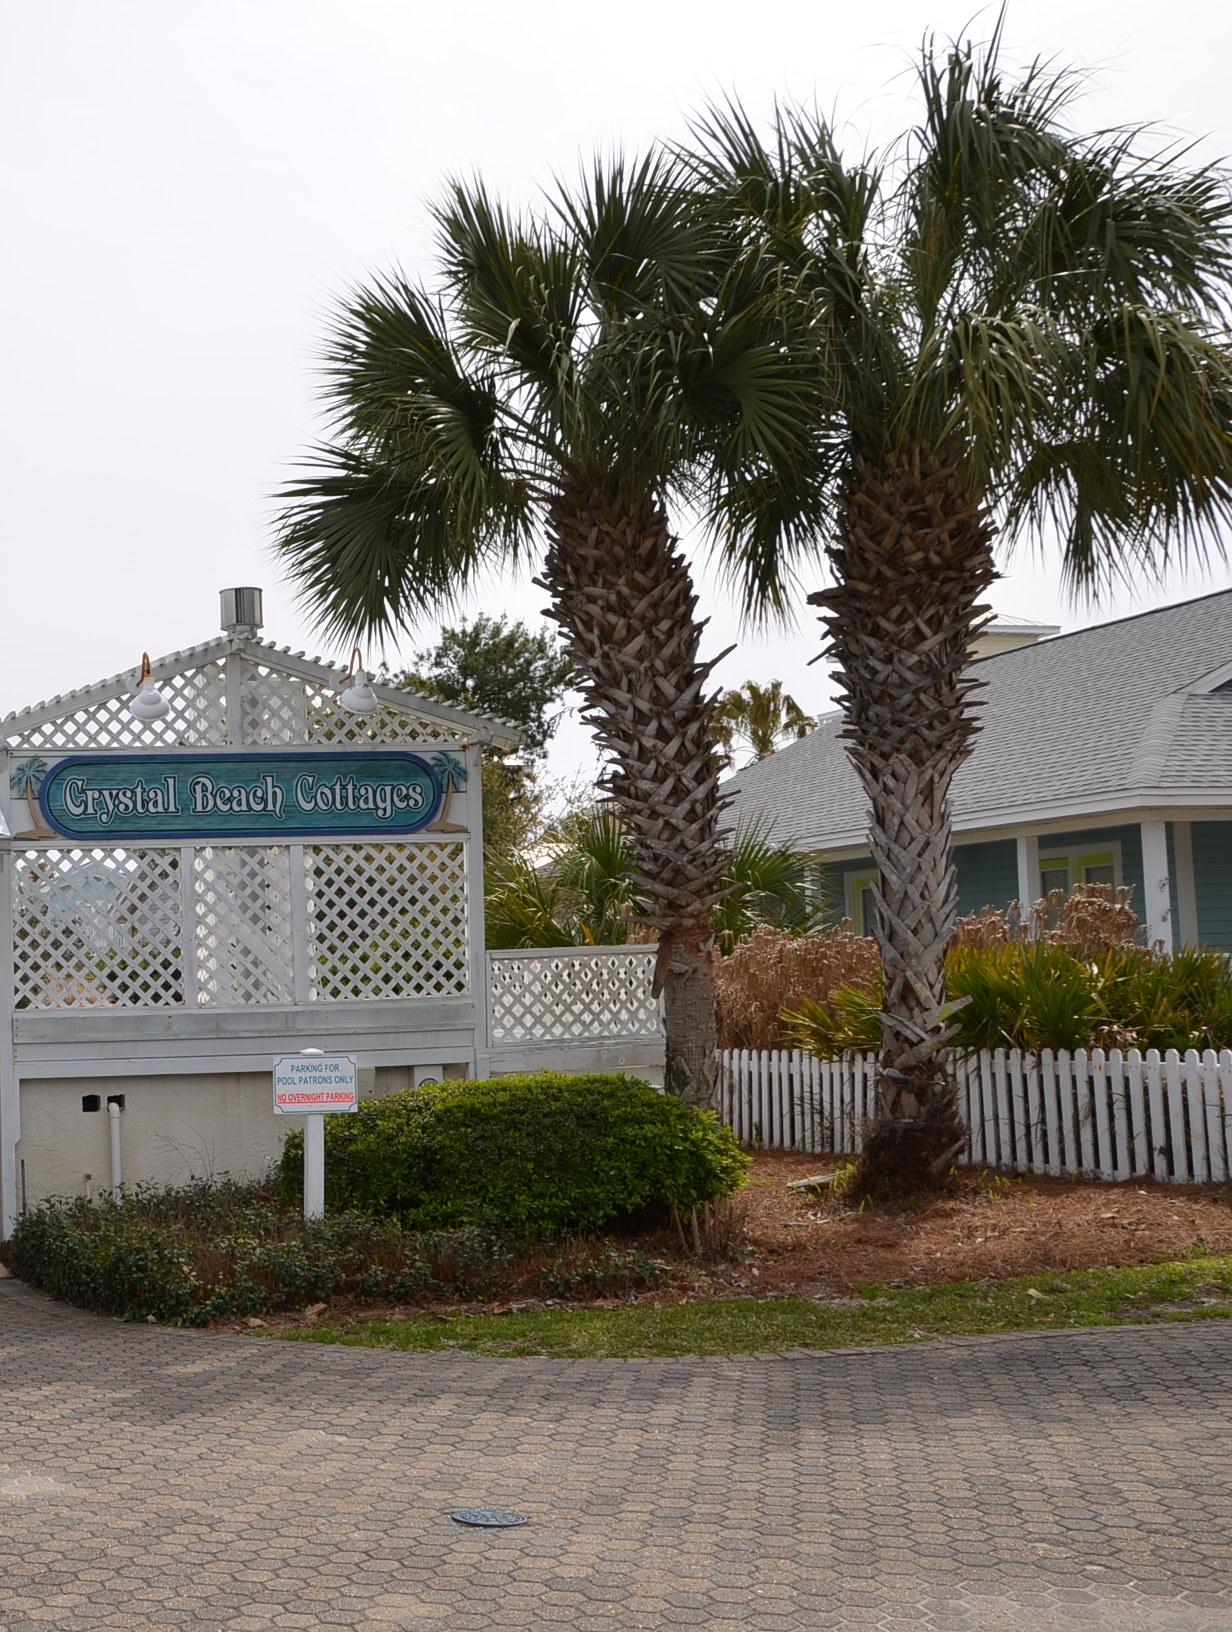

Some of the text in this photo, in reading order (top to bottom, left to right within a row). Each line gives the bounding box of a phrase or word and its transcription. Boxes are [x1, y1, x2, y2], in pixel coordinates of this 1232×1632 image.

[64, 773, 424, 822] Crystal Beach Cottages
[291, 1063, 339, 1073] PARKING FOR
[277, 1075, 353, 1086] POOL PATRONS ONLY
[278, 1091, 354, 1102] NO OVERNIGHT PARKING
